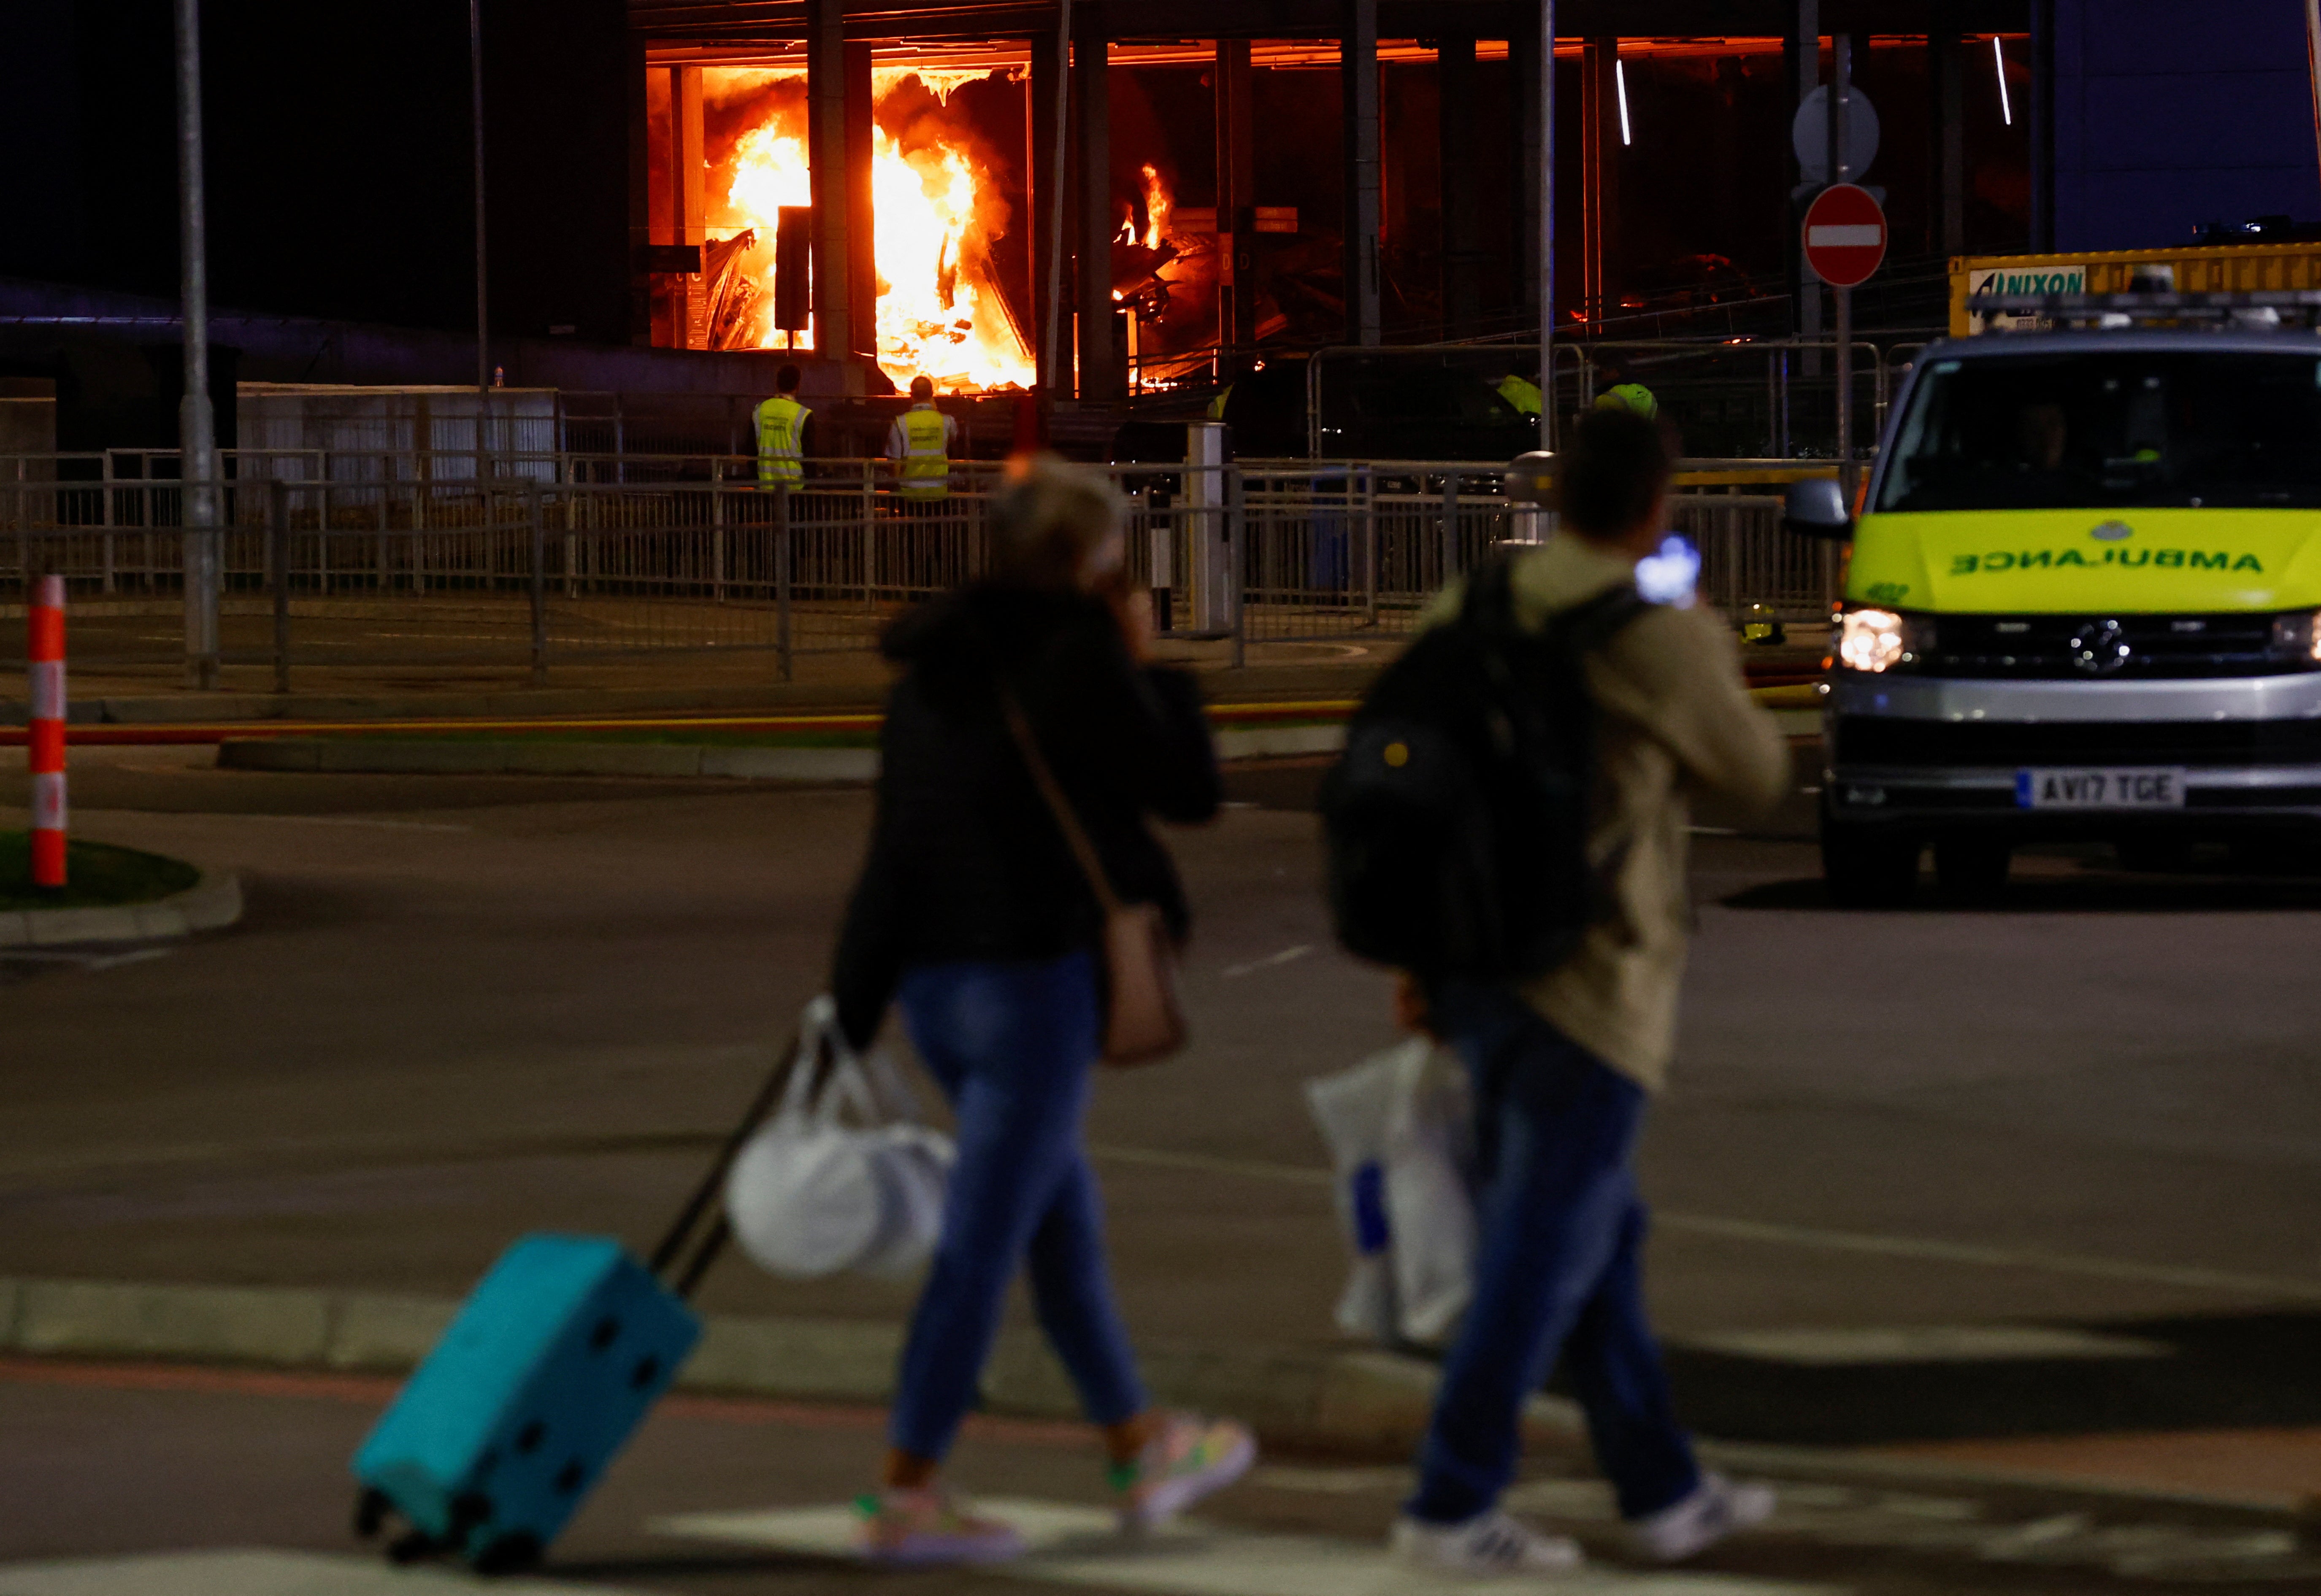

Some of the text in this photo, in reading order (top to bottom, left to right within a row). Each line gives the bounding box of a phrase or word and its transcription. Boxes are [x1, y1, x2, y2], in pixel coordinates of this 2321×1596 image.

[2007, 273, 2083, 295] NIXON
[2042, 773, 2172, 801] AV17 TGE
